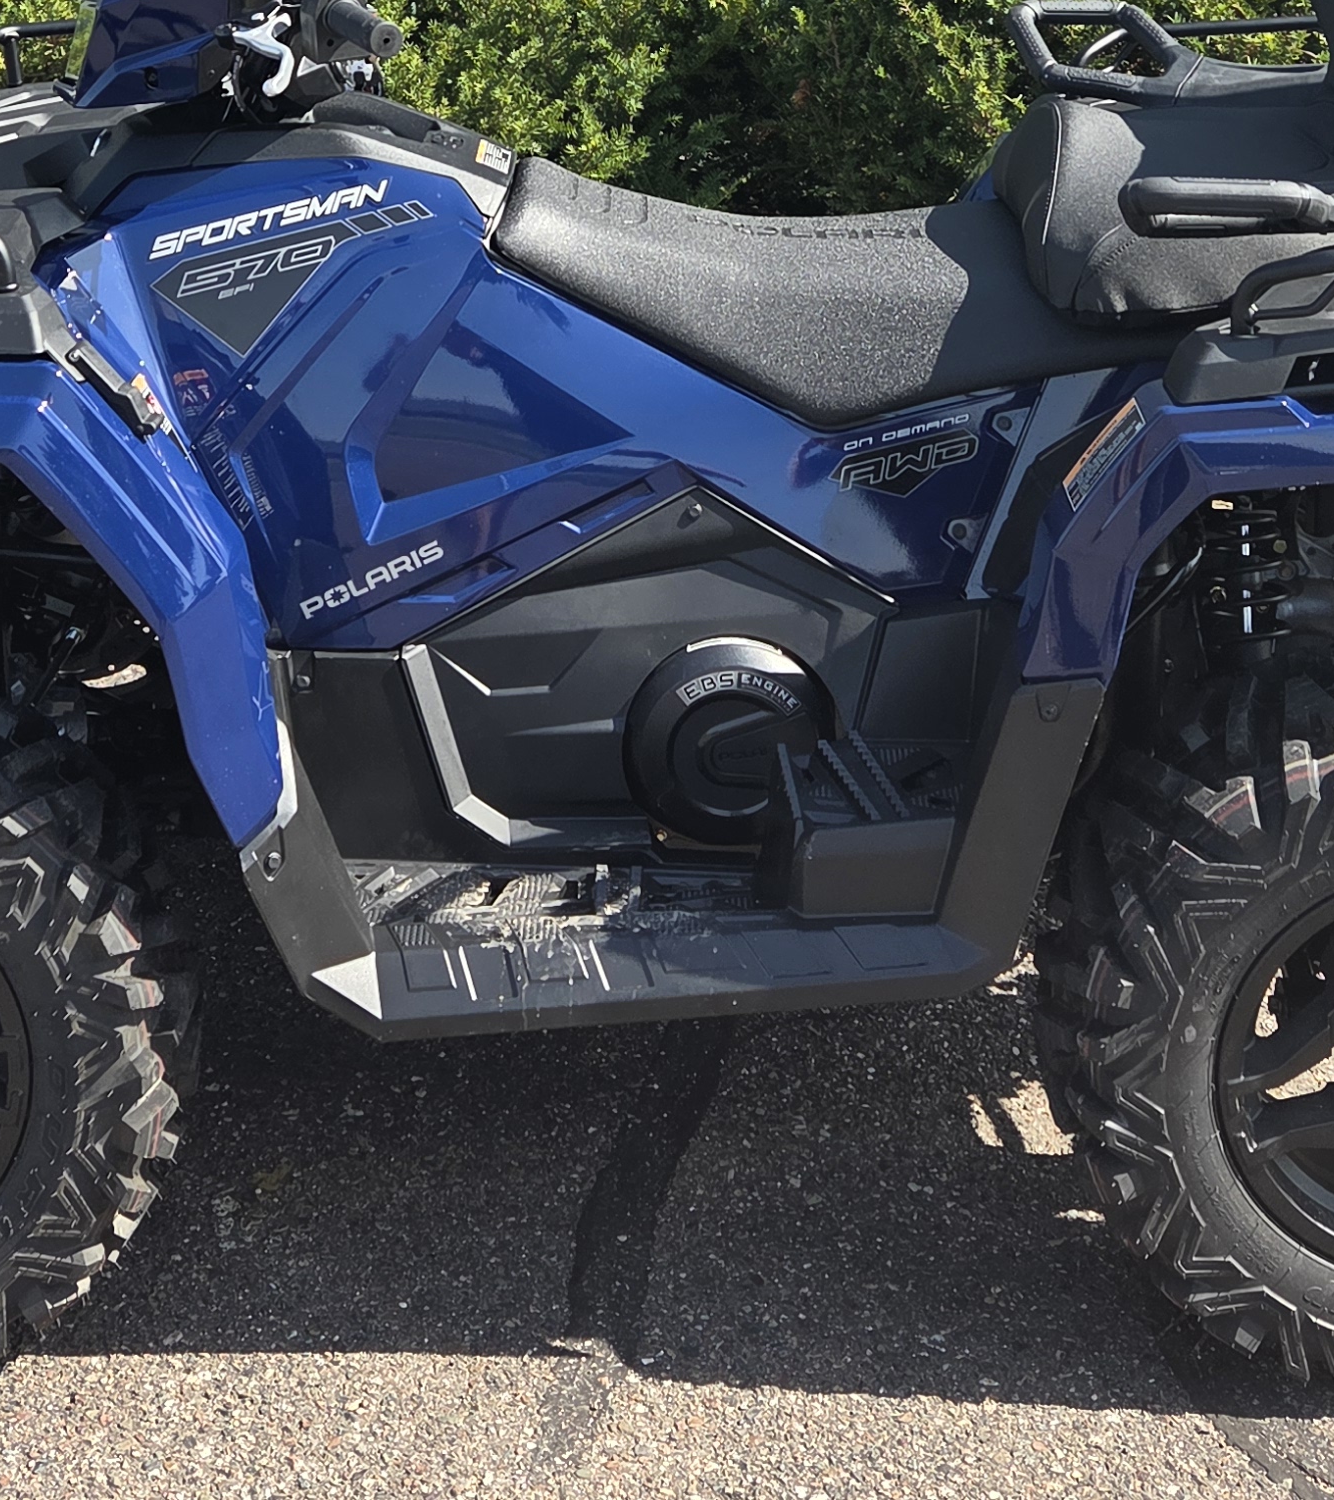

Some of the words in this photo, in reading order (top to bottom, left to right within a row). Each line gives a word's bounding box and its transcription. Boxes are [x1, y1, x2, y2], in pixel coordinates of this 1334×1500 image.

[148, 179, 388, 260] SPORTSMAN
[177, 235, 335, 298] 570
[843, 436, 873, 451] ON
[881, 413, 970, 442] DEMAND
[839, 434, 979, 492] AWD
[299, 539, 445, 620] POLARIS
[683, 673, 735, 700] EBS
[740, 673, 799, 710] ENGINE
